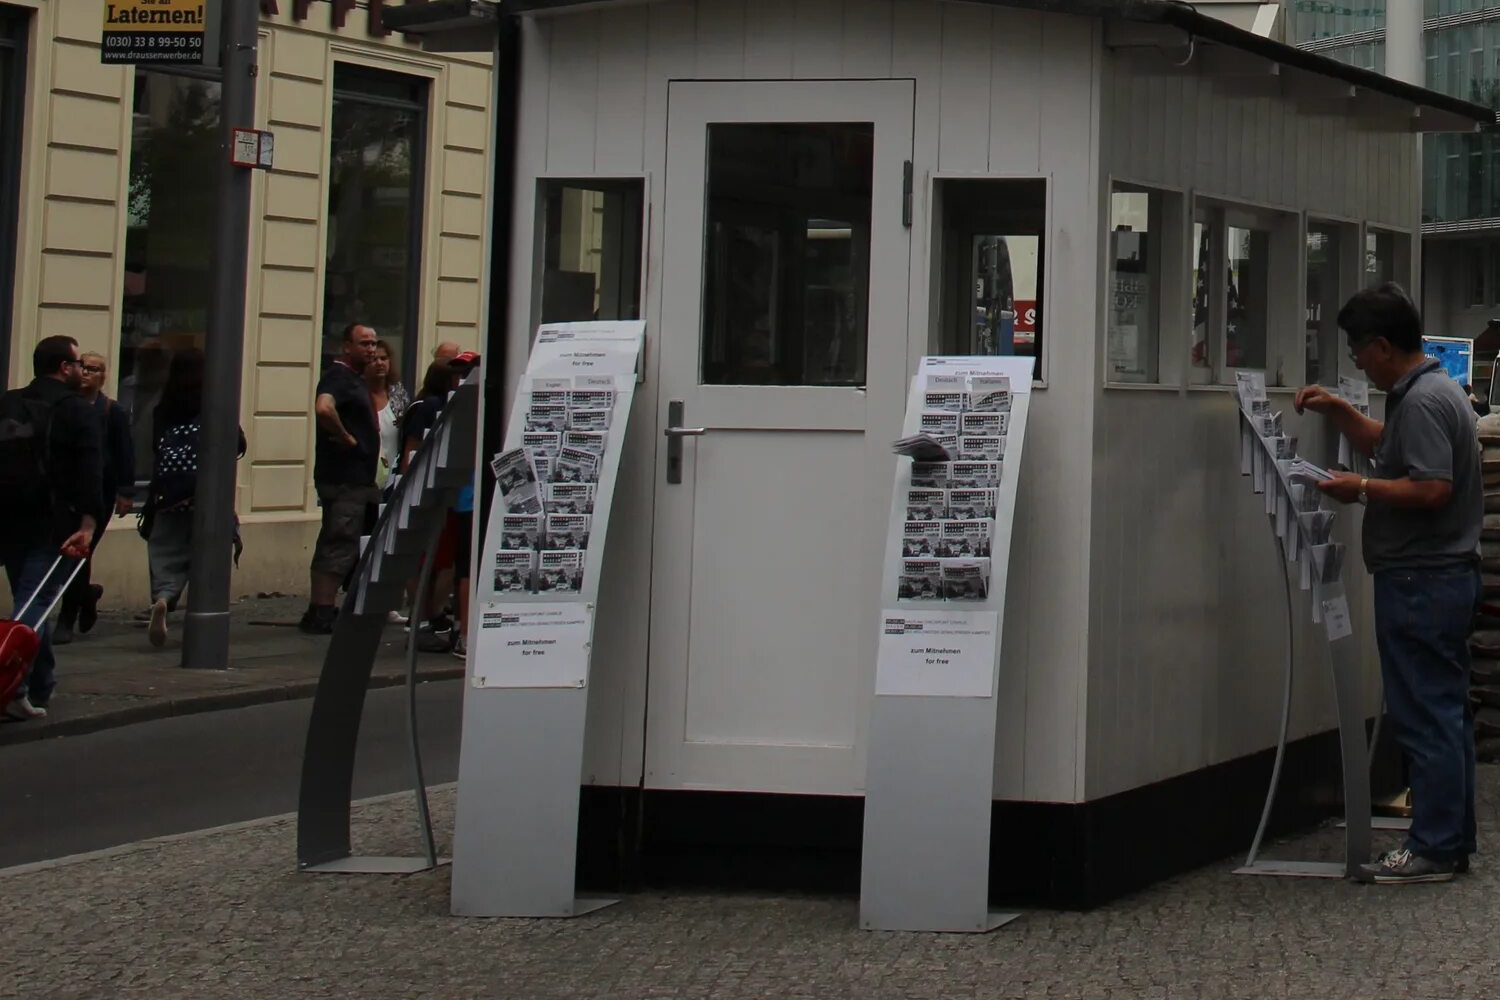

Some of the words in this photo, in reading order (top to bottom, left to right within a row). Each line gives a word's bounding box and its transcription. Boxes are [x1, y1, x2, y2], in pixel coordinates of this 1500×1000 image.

[107, 4, 203, 24] Laternen!
[106, 36, 131, 47] (030)
[135, 37, 145, 47] 33
[149, 37, 154, 47] 8
[158, 37, 185, 47] 99-50
[189, 37, 201, 47] 50
[105, 51, 201, 60] www.draussenwerber.de
